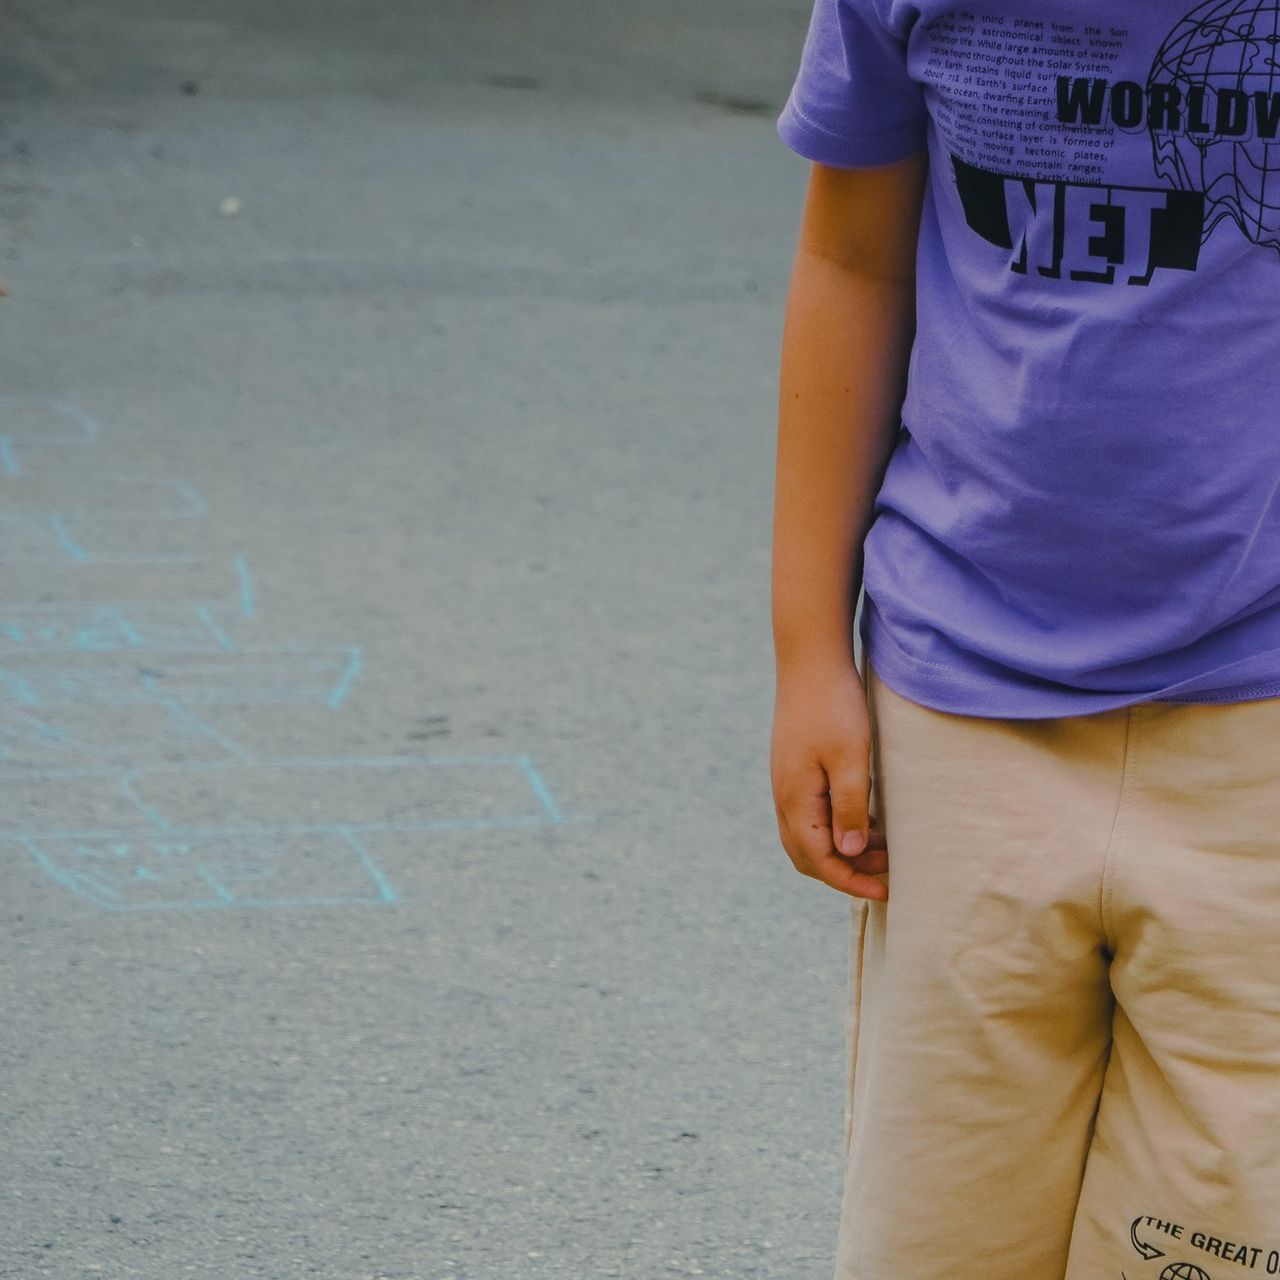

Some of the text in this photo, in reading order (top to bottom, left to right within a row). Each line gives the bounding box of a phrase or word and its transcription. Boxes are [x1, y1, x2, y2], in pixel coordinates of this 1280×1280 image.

[958, 25, 976, 36] only
[982, 28, 1043, 41] astronomical
[1051, 34, 1080, 46] object
[1089, 38, 1123, 48] known
[982, 15, 1004, 25] third
[1014, 19, 1044, 30] planet
[1051, 22, 1074, 33] from
[1084, 26, 1102, 36] the
[1110, 27, 1128, 37] Sun
[950, 48, 971, 60] found
[973, 52, 1025, 66] throughout
[1027, 58, 1044, 68] the
[1047, 60, 1072, 70] Solar
[1075, 61, 1113, 75] System,
[977, 40, 1002, 51] While
[1004, 42, 1029, 55] large
[1032, 46, 1074, 58] amounts
[1077, 49, 1088, 58] of
[1090, 51, 1119, 61] water
[928, 58, 942, 68] only
[945, 60, 963, 71] Earth
[966, 64, 999, 76] sustains
[1004, 68, 1032, 80] liquid
[923, 68, 944, 79] About
[963, 75, 973, 85] of
[976, 77, 1007, 90] Earth's
[1012, 82, 1048, 94] surface
[953, 88, 980, 100] ocean,
[983, 91, 1024, 106] dwarfing
[982, 104, 998, 114] The
[1001, 107, 1049, 121] remaining
[977, 117, 1022, 131] consisting
[1025, 122, 1036, 131] of
[1039, 123, 1092, 135] continents
[1096, 127, 1114, 136] and
[982, 130, 1014, 141] surface
[1020, 133, 1044, 145] layer
[1049, 135, 1057, 144] is
[1063, 136, 1100, 148] formed
[1103, 139, 1115, 149] of
[979, 152, 1012, 166] produce
[1017, 159, 1062, 170] mountain
[1068, 163, 1104, 174] ranges,
[983, 142, 1014, 156] moving
[1025, 147, 1065, 158] tectonic
[1074, 150, 1107, 162] plates,
[1003, 177, 1168, 287] NET
[1145, 1216, 1185, 1241] THE
[1190, 1232, 1263, 1269] GREAT
